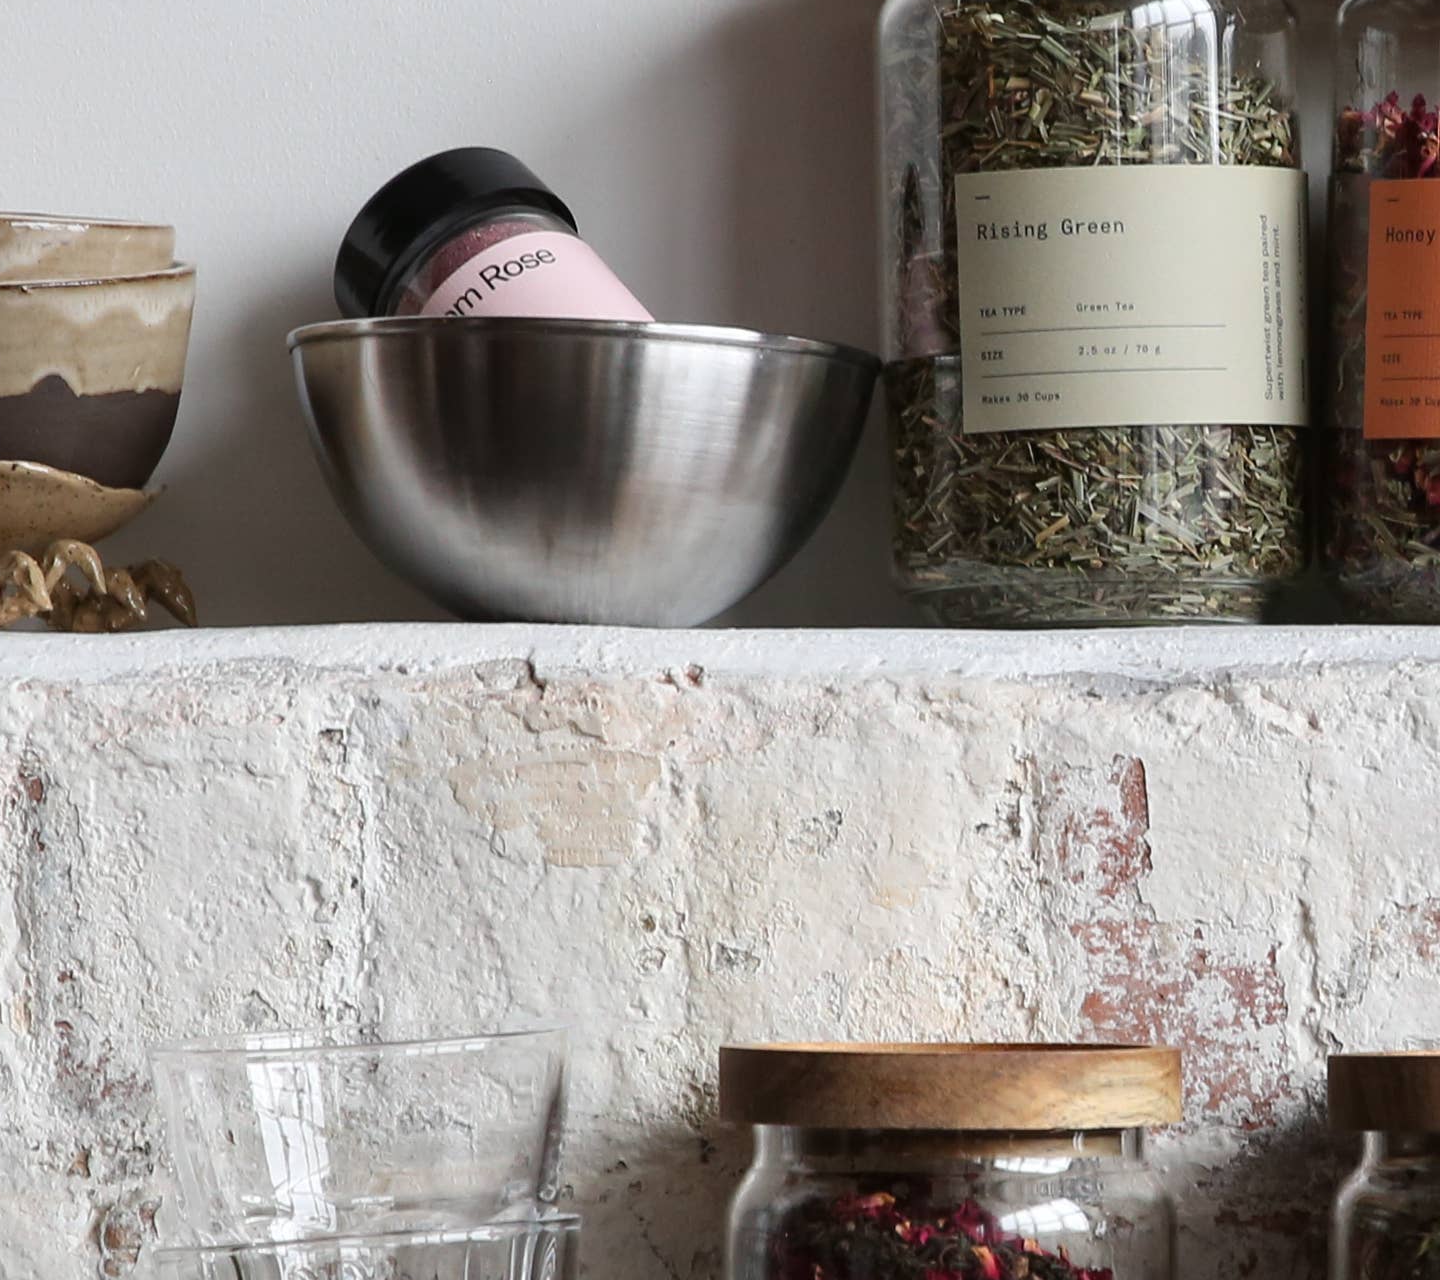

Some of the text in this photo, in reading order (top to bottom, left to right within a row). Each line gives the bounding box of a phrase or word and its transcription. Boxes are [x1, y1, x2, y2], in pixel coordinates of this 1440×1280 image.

[977, 219, 1124, 240] Rising Green
[445, 249, 555, 317] m Rose
[980, 306, 1026, 318] TEA TYPE
[1076, 302, 1134, 312] Green Tea
[1261, 215, 1274, 400] Supertwist green tea paired
[1275, 292, 1285, 367] lemongrass
[981, 350, 1003, 361] SIZE
[1079, 346, 1097, 355] 2.5
[1104, 346, 1116, 354] oz
[1136, 344, 1148, 353] 70
[981, 391, 1060, 405] Makes 30 Cups
